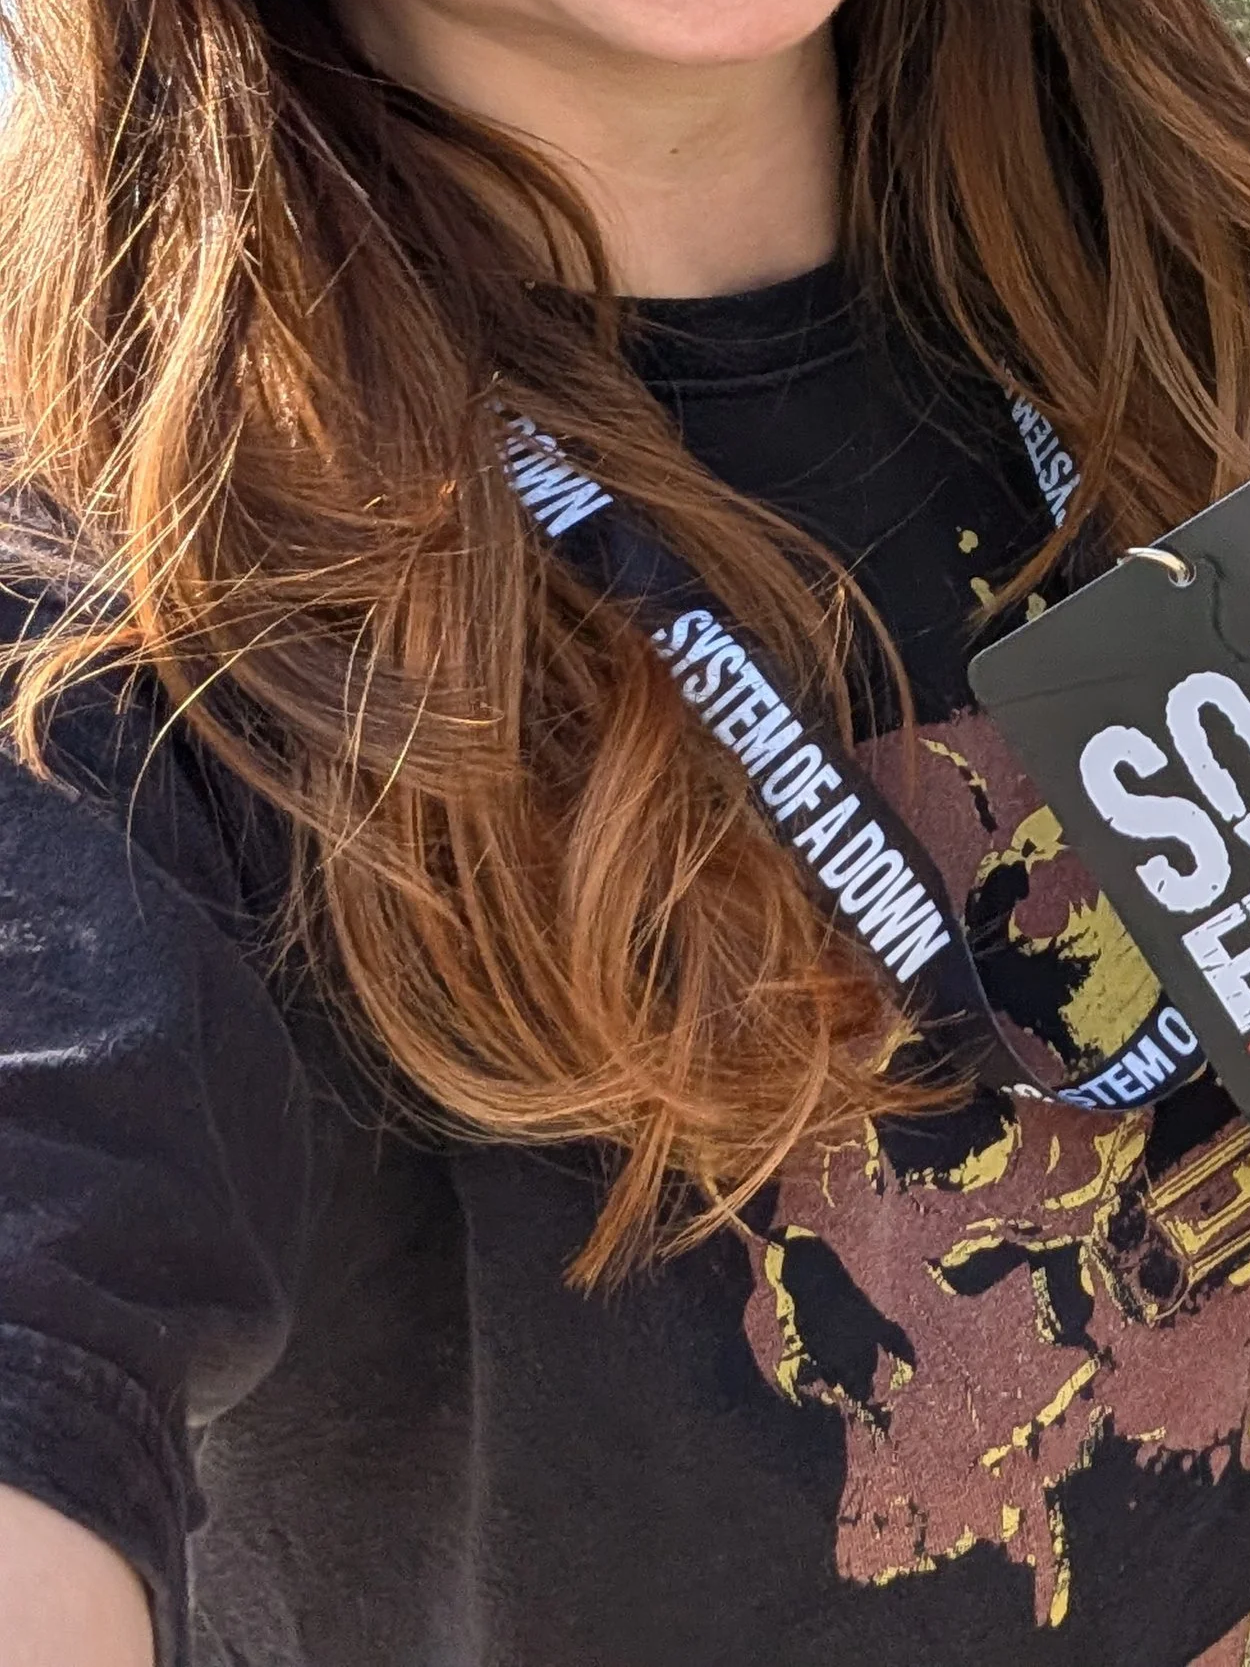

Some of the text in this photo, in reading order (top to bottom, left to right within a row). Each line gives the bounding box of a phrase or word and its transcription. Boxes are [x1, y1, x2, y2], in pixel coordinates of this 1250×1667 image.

[1011, 394, 1081, 530] YSTEM
[651, 609, 951, 983] SYSTEM OF A DOWN
